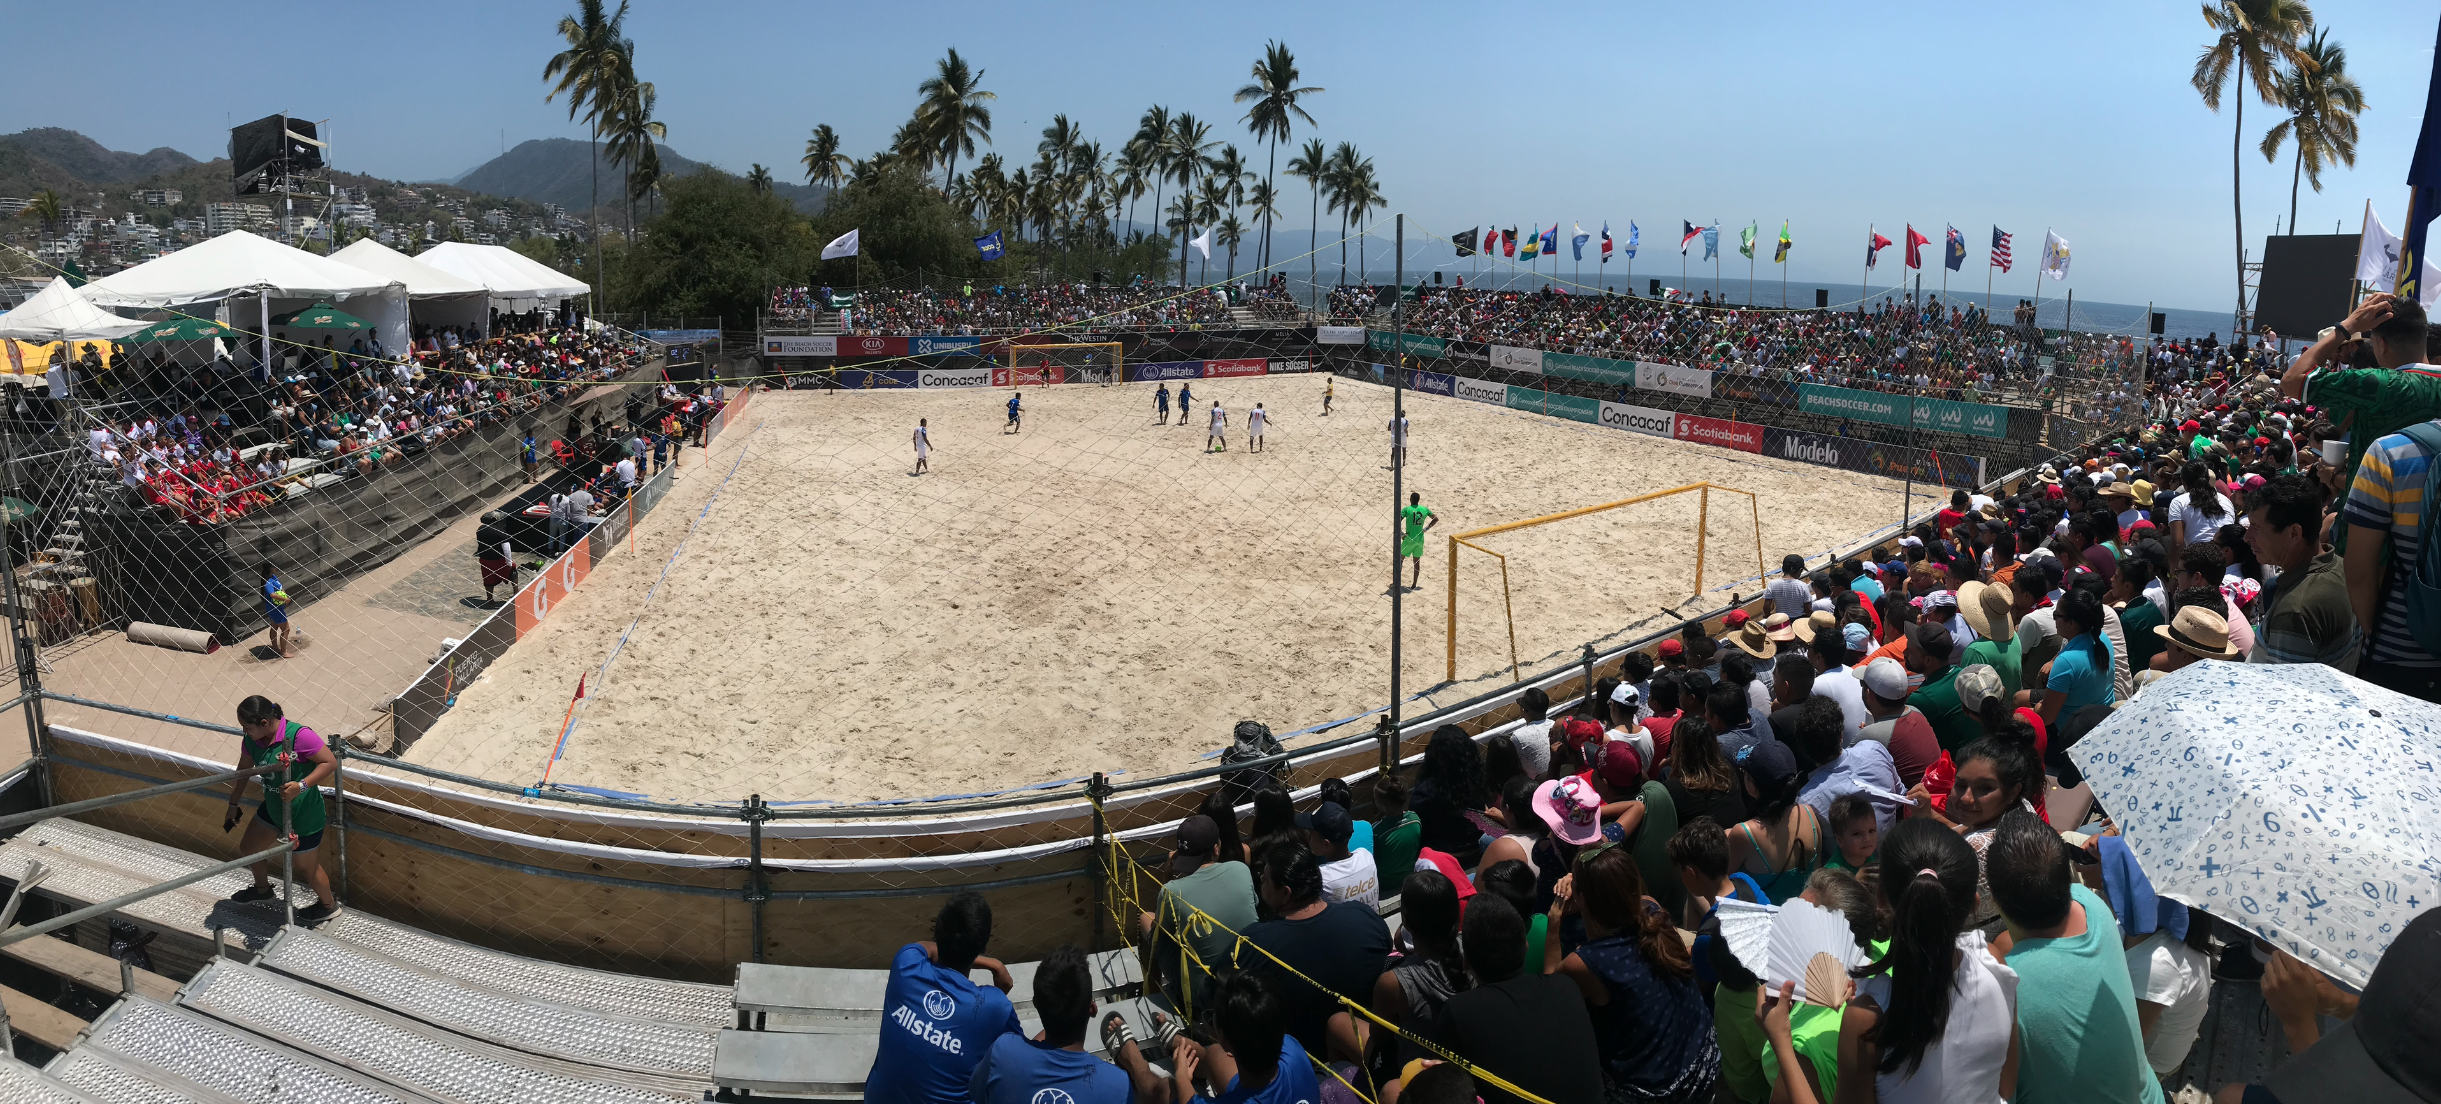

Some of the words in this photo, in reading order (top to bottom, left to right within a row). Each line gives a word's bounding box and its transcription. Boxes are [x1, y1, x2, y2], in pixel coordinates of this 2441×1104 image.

[865, 340, 881, 348] KIA
[1159, 366, 1195, 377] Allstate
[1217, 364, 1261, 374] Scotiabank
[1269, 361, 1285, 372] NIKE
[1285, 360, 1309, 371] SOCCER
[798, 376, 822, 385] MMC
[922, 373, 989, 387] Concacaf
[1424, 378, 1449, 391] Allstate
[1457, 381, 1504, 403] Concacaf
[1807, 394, 1892, 415] BEACHSOCCER.COM
[1217, 411, 1222, 420] 2
[1602, 406, 1671, 433] Concacaf
[1693, 425, 1753, 445] Scotiabank
[1784, 435, 1838, 465] Modelo
[1412, 511, 1423, 525] 12
[563, 551, 576, 593] G
[533, 575, 548, 621] G
[891, 1004, 962, 1055] Allstate
